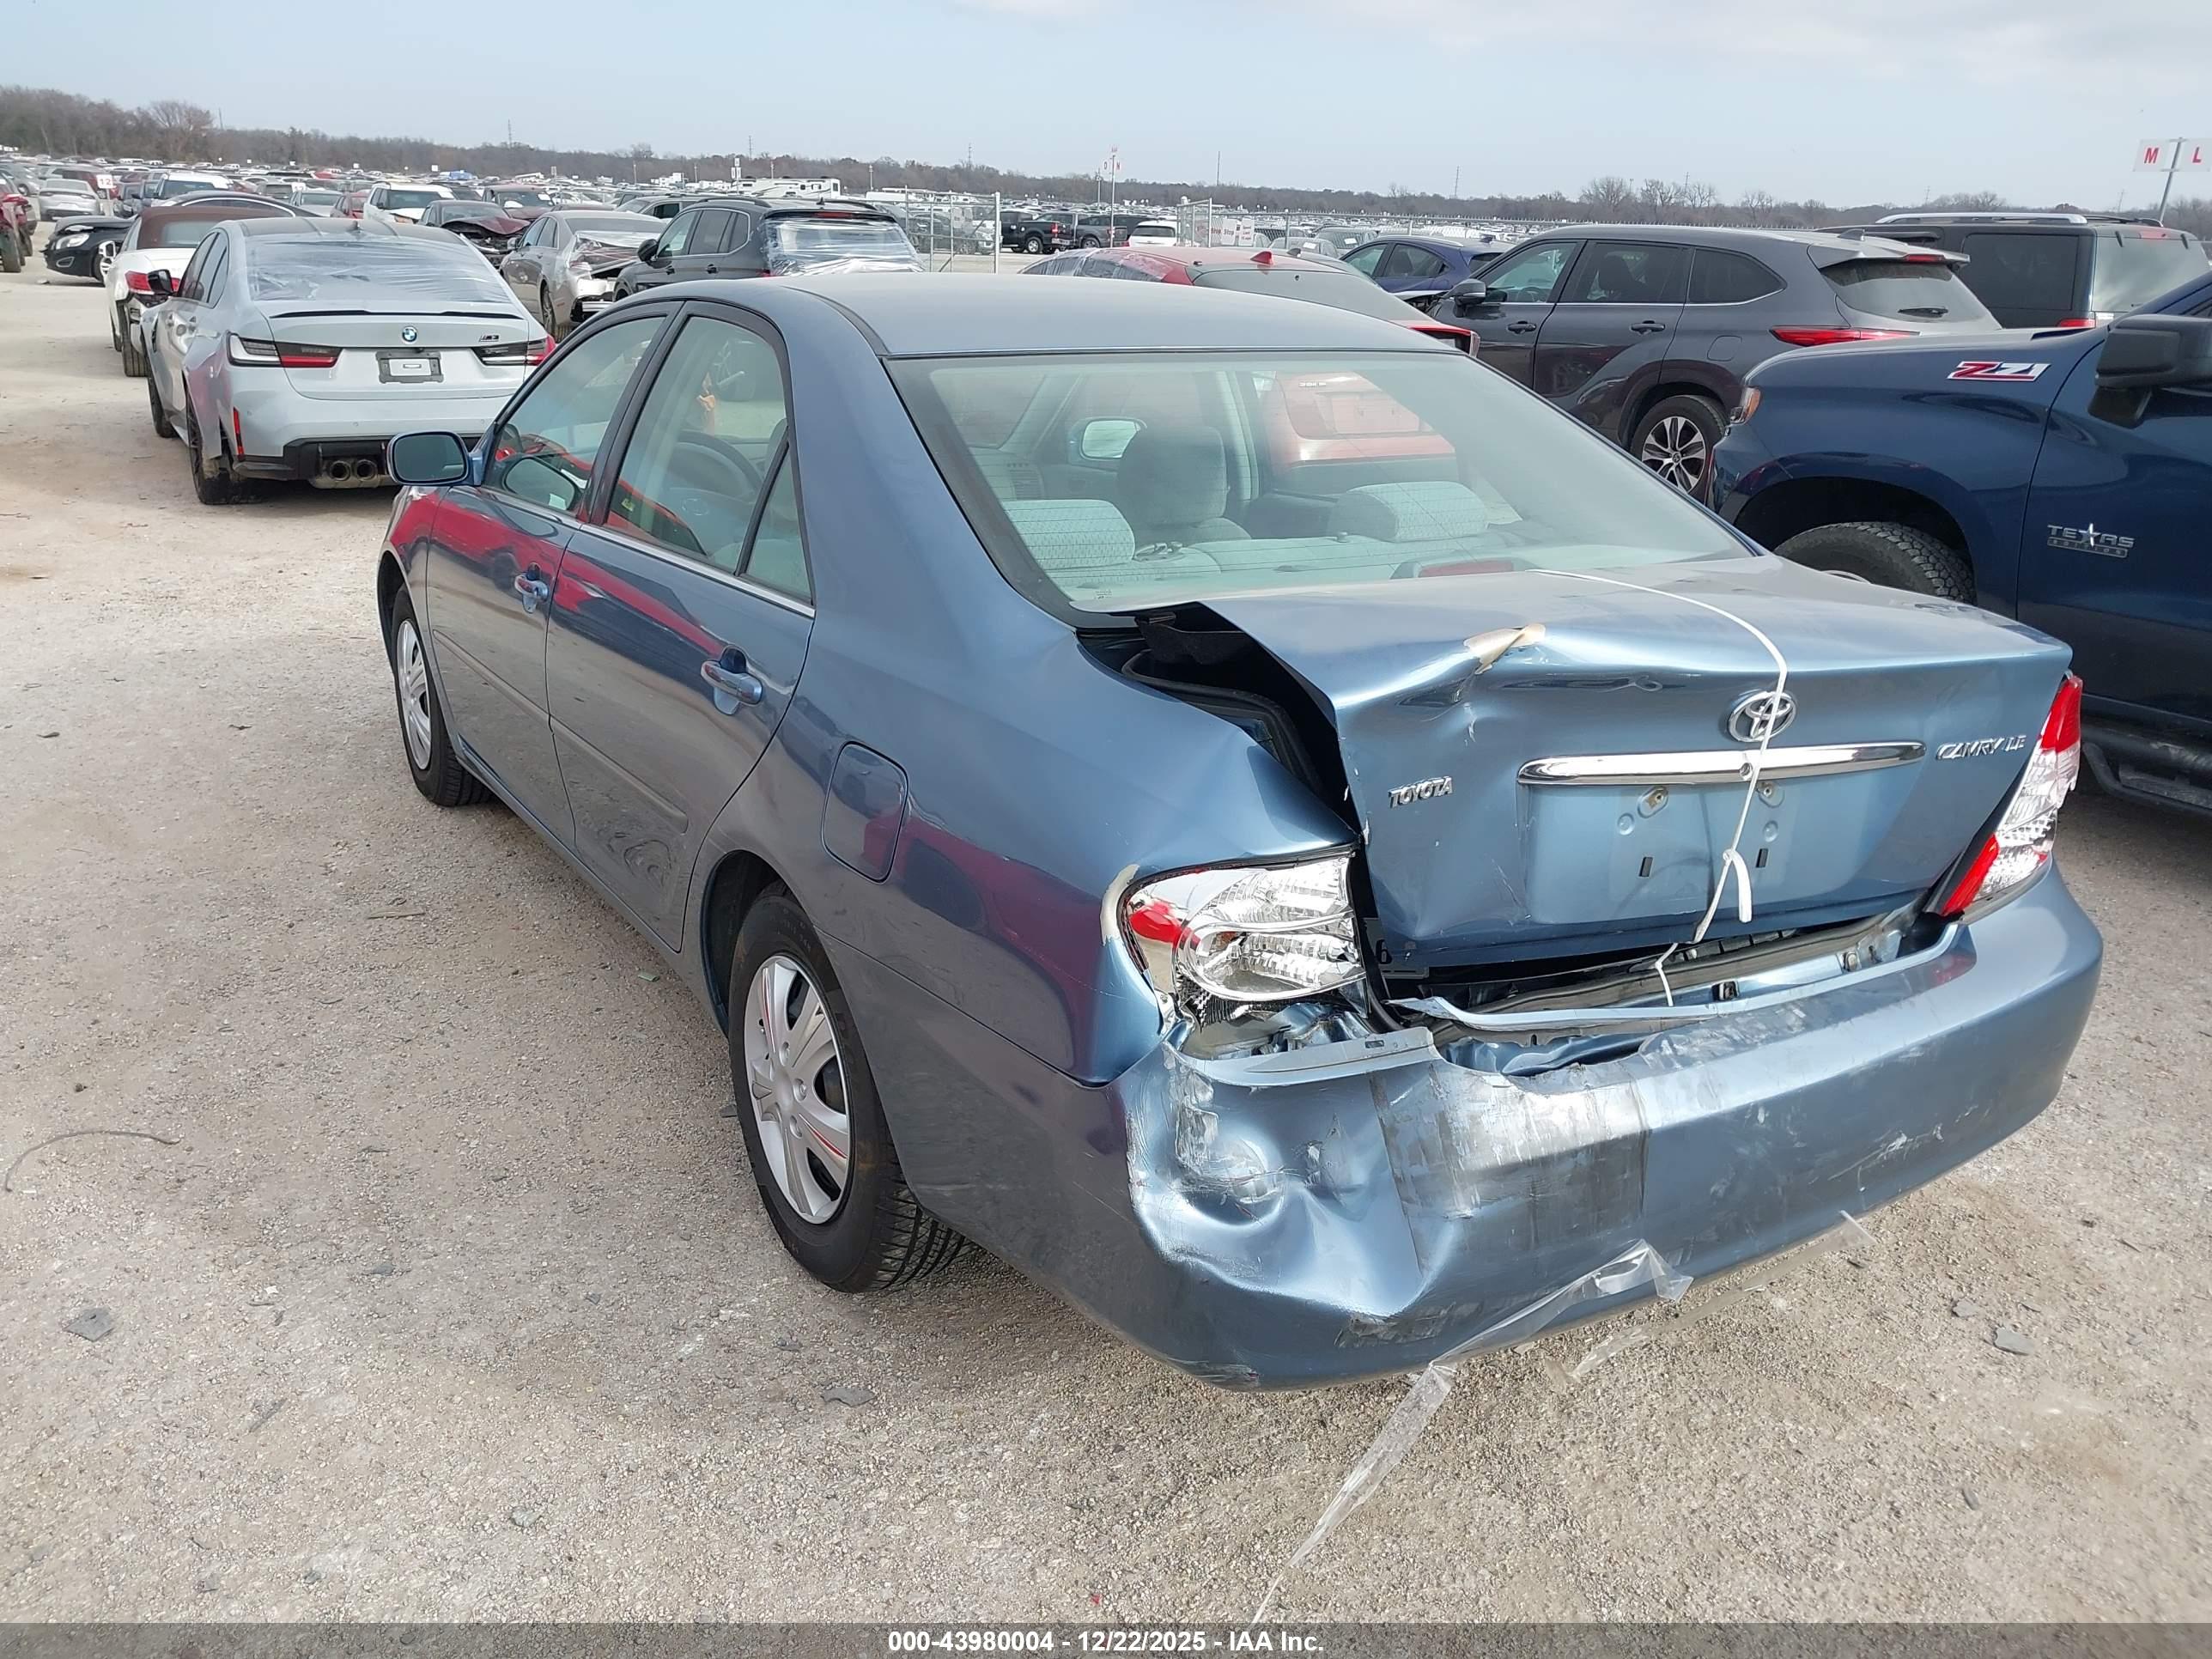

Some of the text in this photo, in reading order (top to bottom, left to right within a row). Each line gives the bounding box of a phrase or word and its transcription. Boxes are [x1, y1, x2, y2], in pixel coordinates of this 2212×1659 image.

[2143, 147, 2160, 164] M
[2191, 146, 2202, 163] L
[1946, 361, 2052, 382] Z71
[1936, 734, 2027, 760] CAMRY LE
[1388, 775, 1453, 809] TOYOTA
